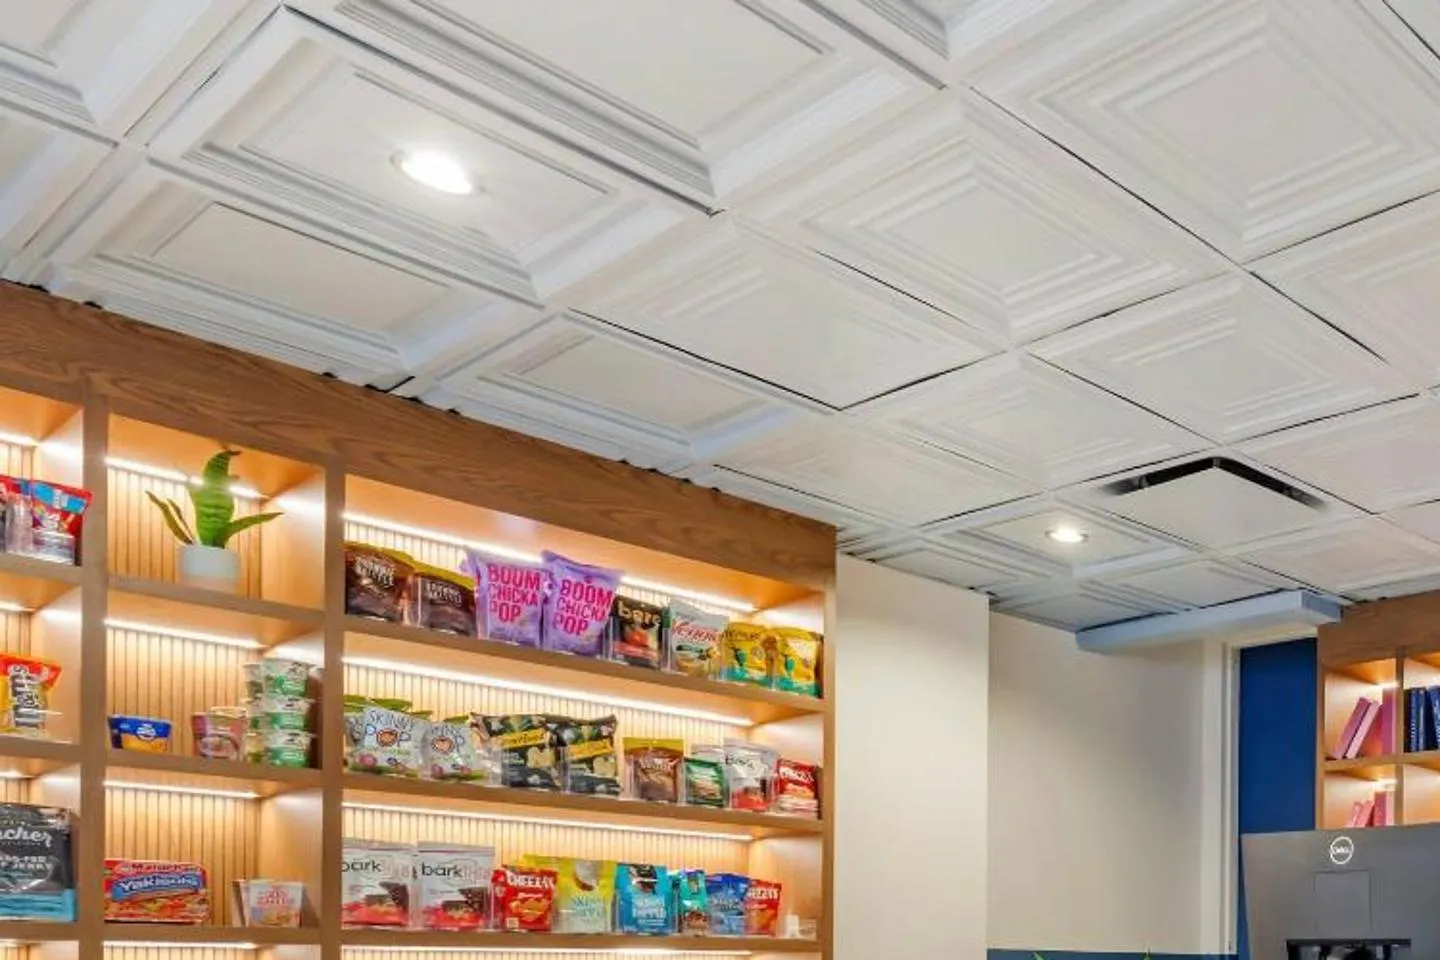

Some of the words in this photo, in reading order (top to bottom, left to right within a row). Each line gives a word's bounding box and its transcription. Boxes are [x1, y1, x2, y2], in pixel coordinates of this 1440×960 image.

[487, 563, 541, 591] BOOM
[488, 583, 538, 607] CHICKA
[560, 579, 615, 607] BOOM
[490, 601, 521, 622] POP
[553, 612, 589, 635] POP
[421, 861, 463, 878] bark
[120, 875, 199, 892] Yakisoba
